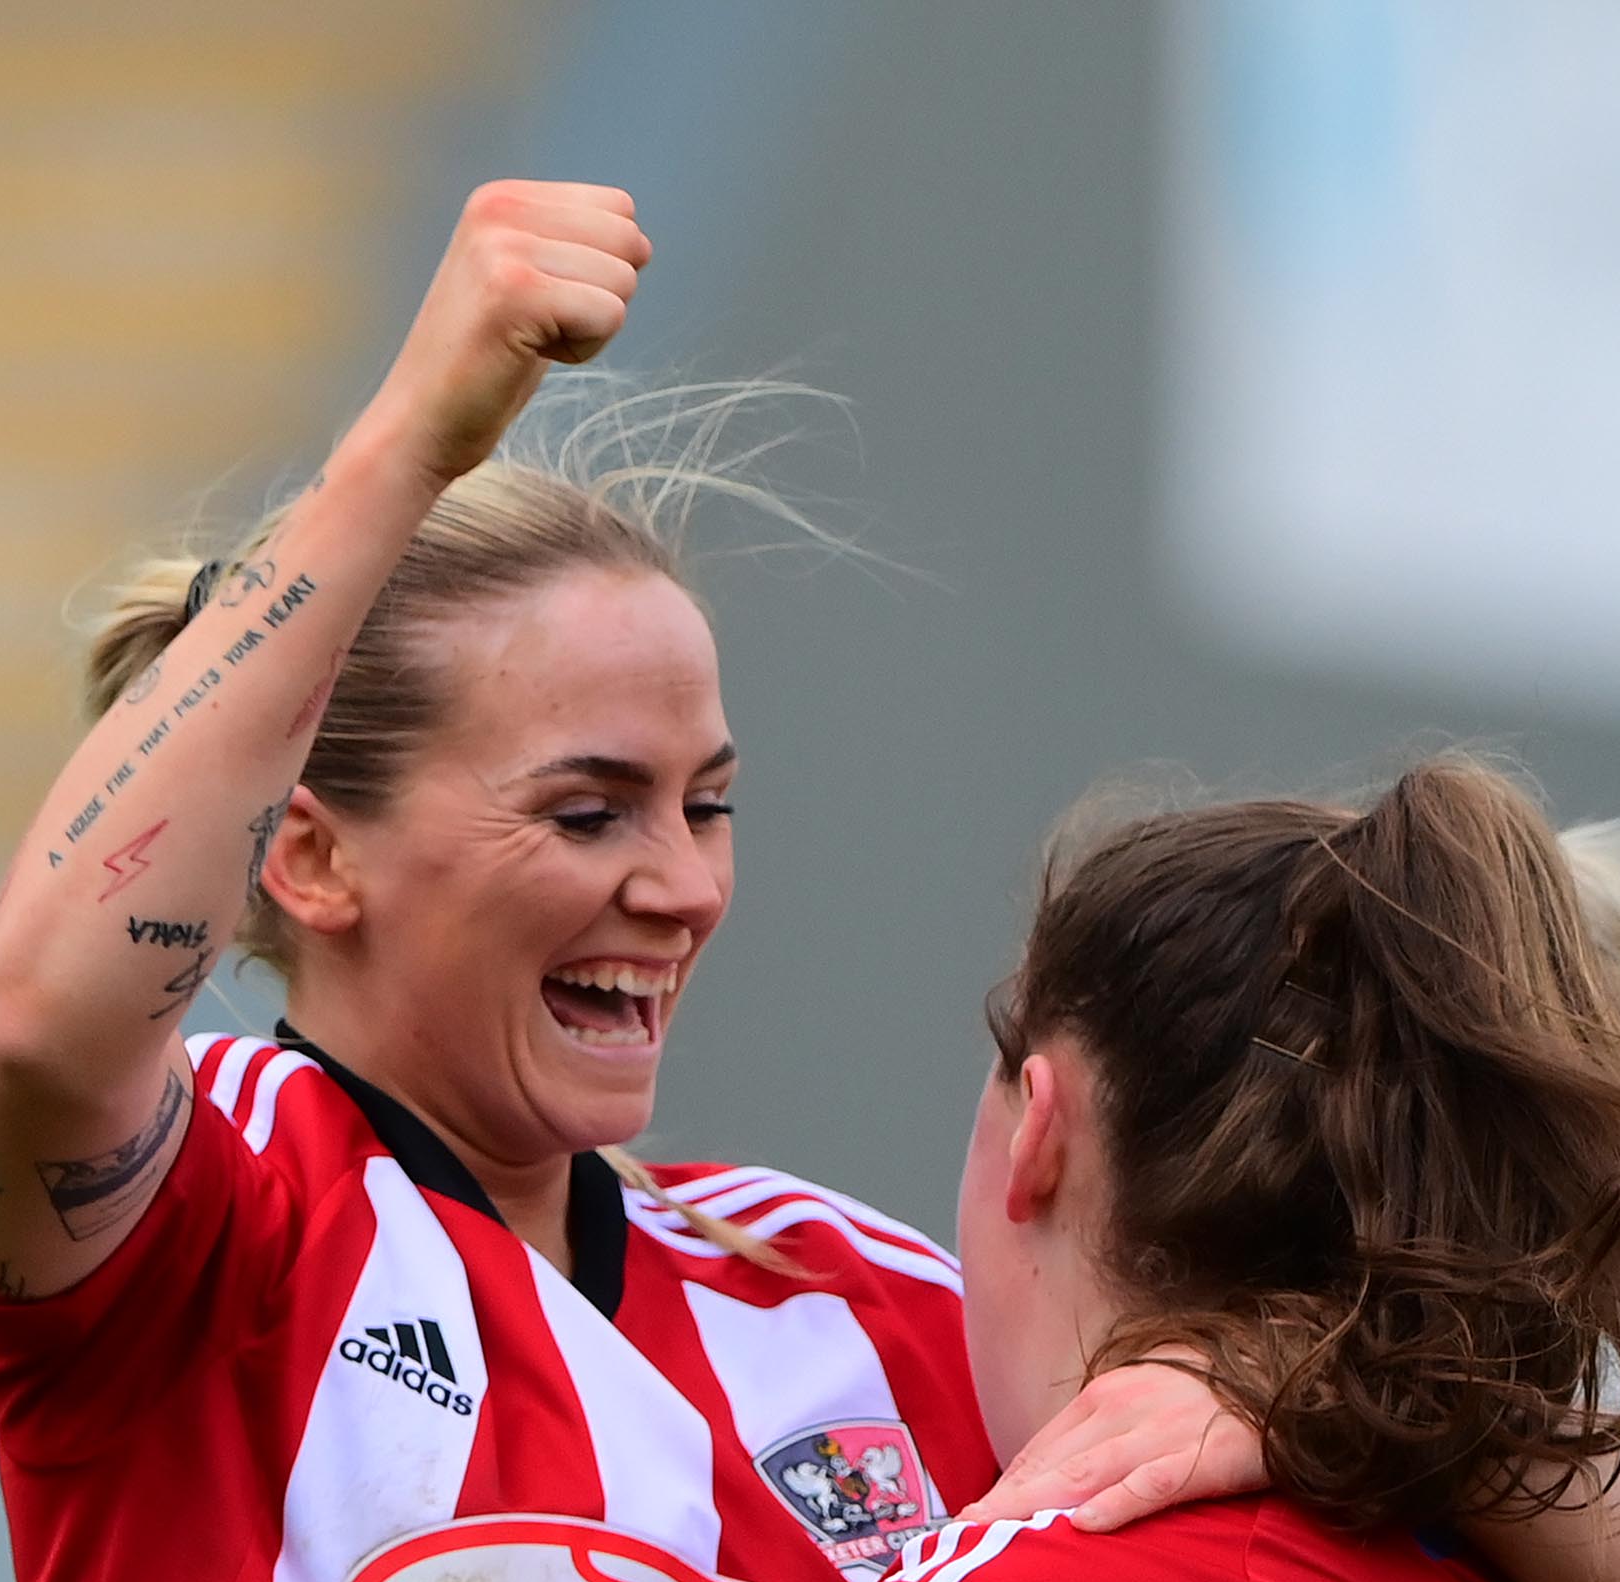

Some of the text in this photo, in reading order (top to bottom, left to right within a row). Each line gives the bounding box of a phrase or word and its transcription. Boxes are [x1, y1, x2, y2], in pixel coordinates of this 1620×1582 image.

[48, 572, 318, 869] A HOUSE FIRE THAT MELTS YOUR HEART
[339, 1338, 473, 1416] adidas
